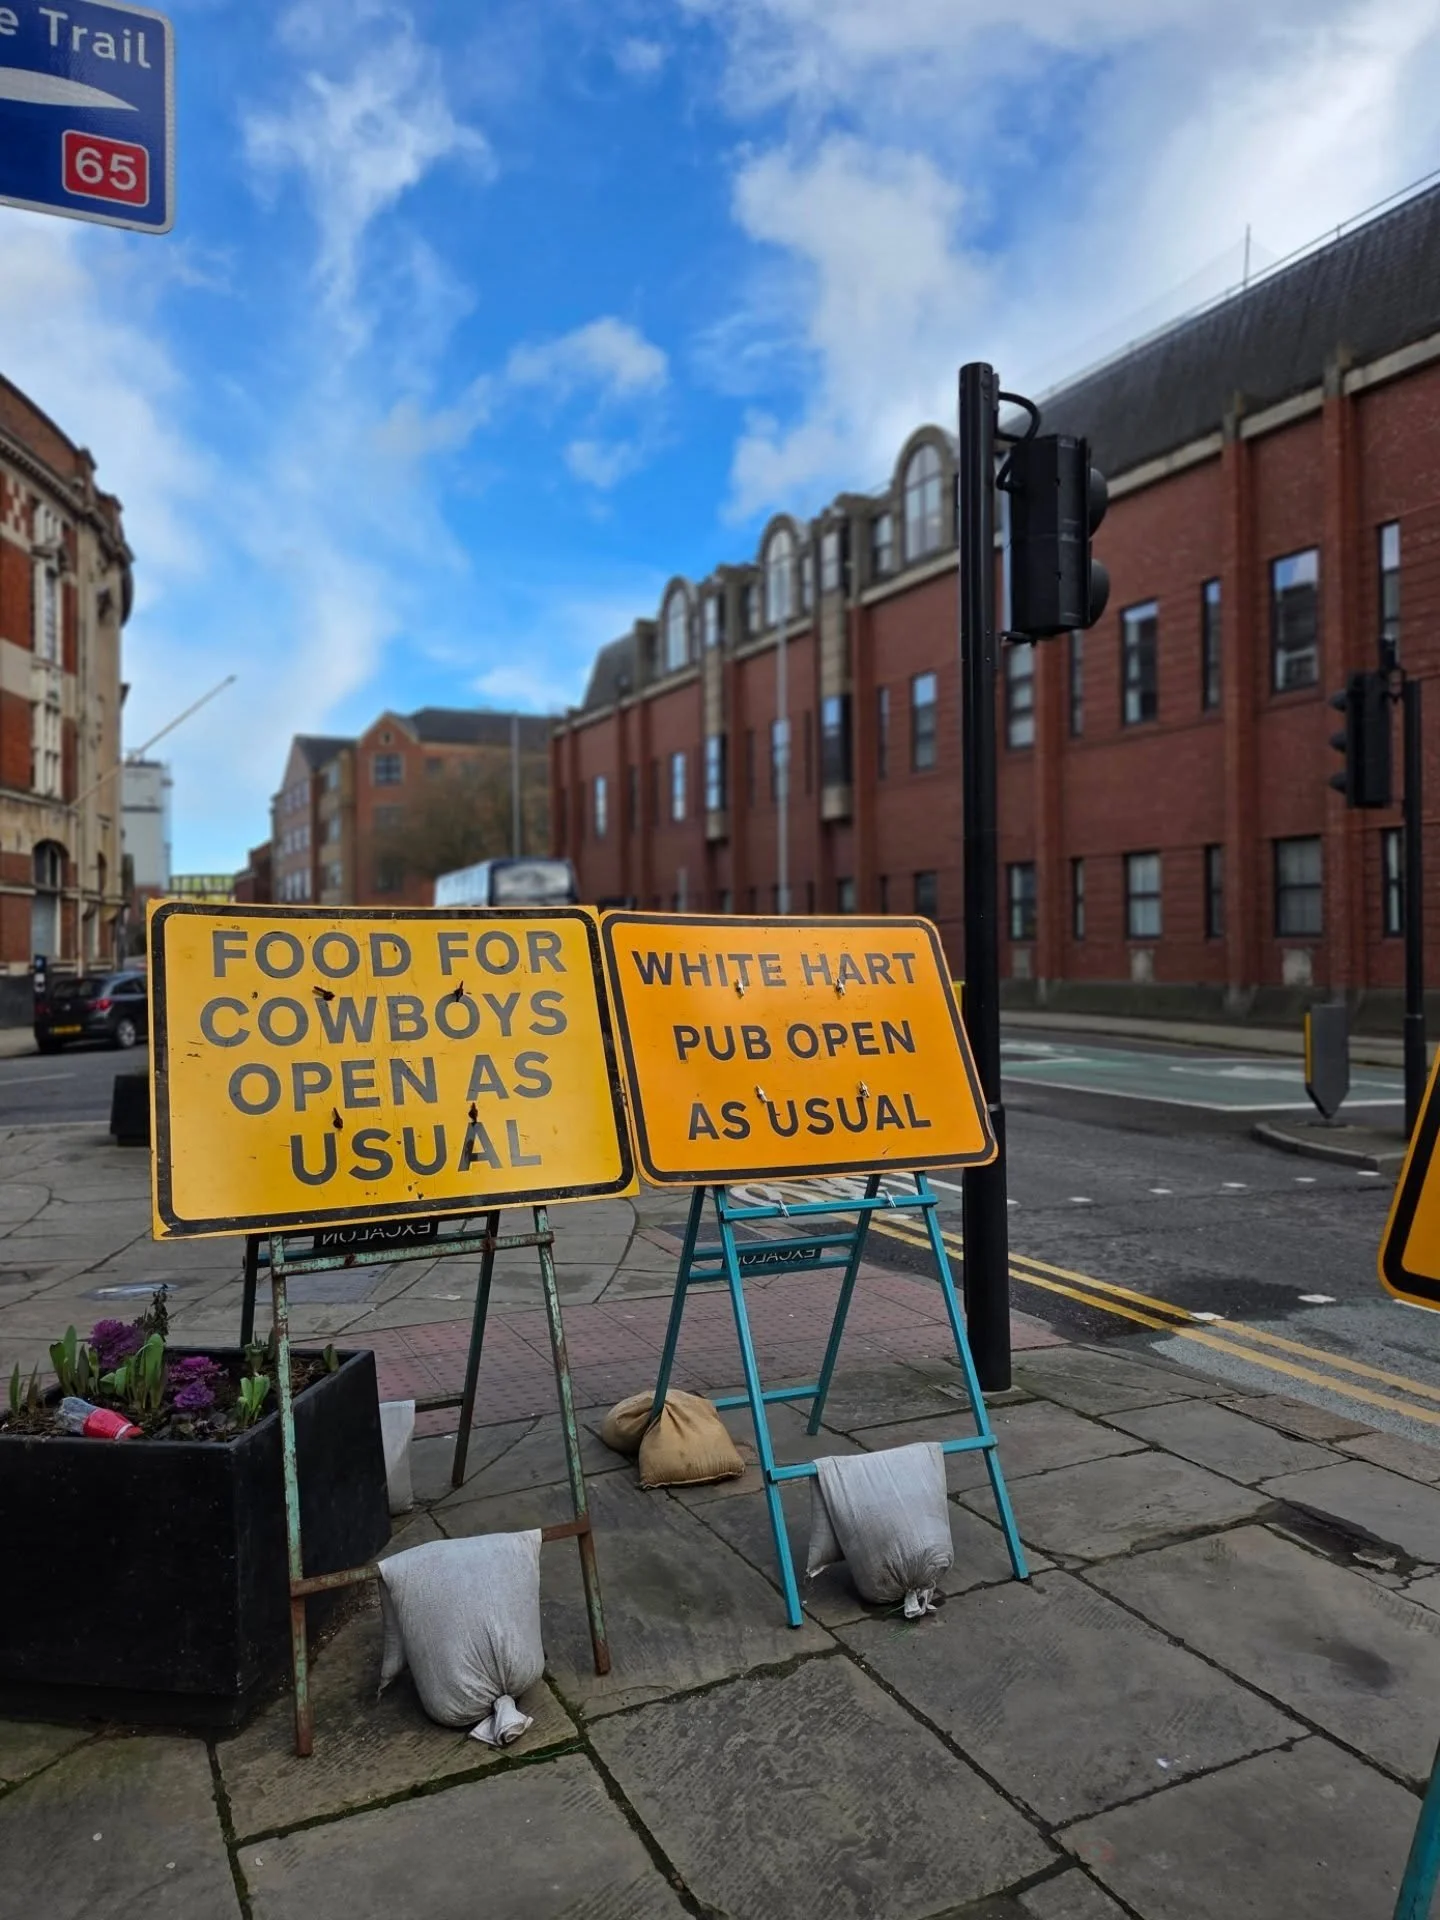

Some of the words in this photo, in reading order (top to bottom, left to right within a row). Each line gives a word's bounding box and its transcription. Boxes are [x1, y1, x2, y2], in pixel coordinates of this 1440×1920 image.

[39, 7, 151, 69] Trail
[75, 147, 137, 191] 65
[212, 930, 411, 979] FOOD
[437, 930, 567, 976] FOR
[631, 951, 787, 988] WHITE
[801, 952, 916, 986] HART
[200, 990, 568, 1047] COWBOYS
[672, 1024, 772, 1061] PUB
[787, 1020, 916, 1059] OPEN
[228, 1056, 438, 1116] OPEN
[466, 1051, 553, 1101] AS
[688, 1102, 751, 1141] AS
[767, 1093, 932, 1137] USUAL
[290, 1119, 542, 1186] USUAL
